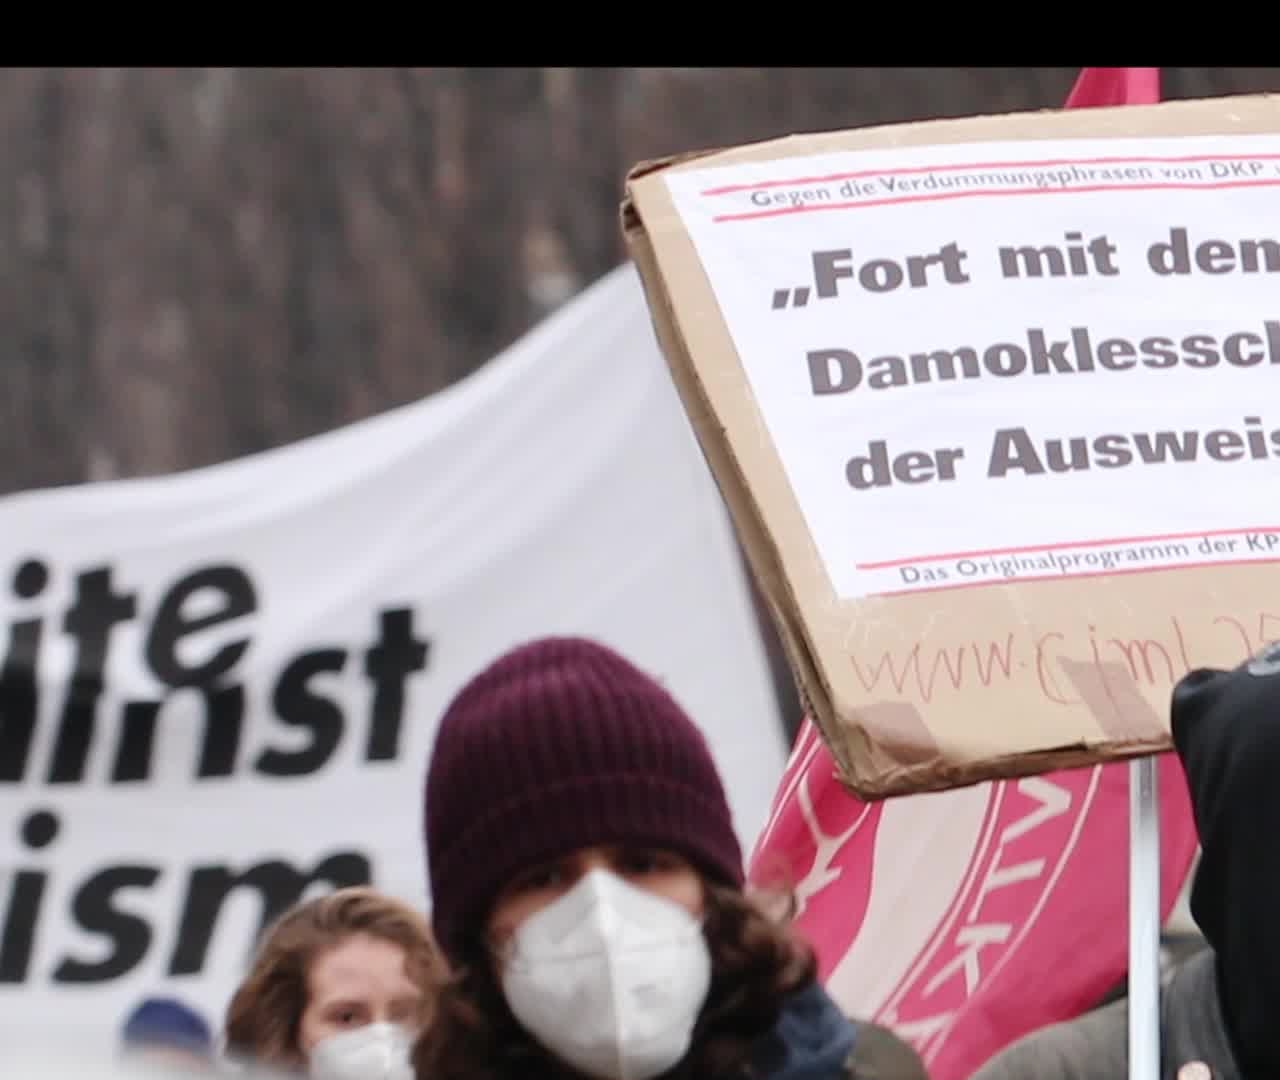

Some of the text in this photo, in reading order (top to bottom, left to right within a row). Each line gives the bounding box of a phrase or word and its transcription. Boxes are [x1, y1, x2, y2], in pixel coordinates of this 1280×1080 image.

[750, 186, 831, 208] Gegen
[839, 175, 878, 198] die
[879, 162, 1153, 193] Verdummungsphrasen
[1161, 165, 1202, 181] von
[1209, 160, 1264, 179] DKP
[771, 240, 971, 310] „Fort
[998, 231, 1120, 278] mit
[845, 439, 966, 491] der
[899, 564, 948, 585] Das
[955, 542, 1191, 580] Originalprogramm
[1197, 536, 1238, 556] der
